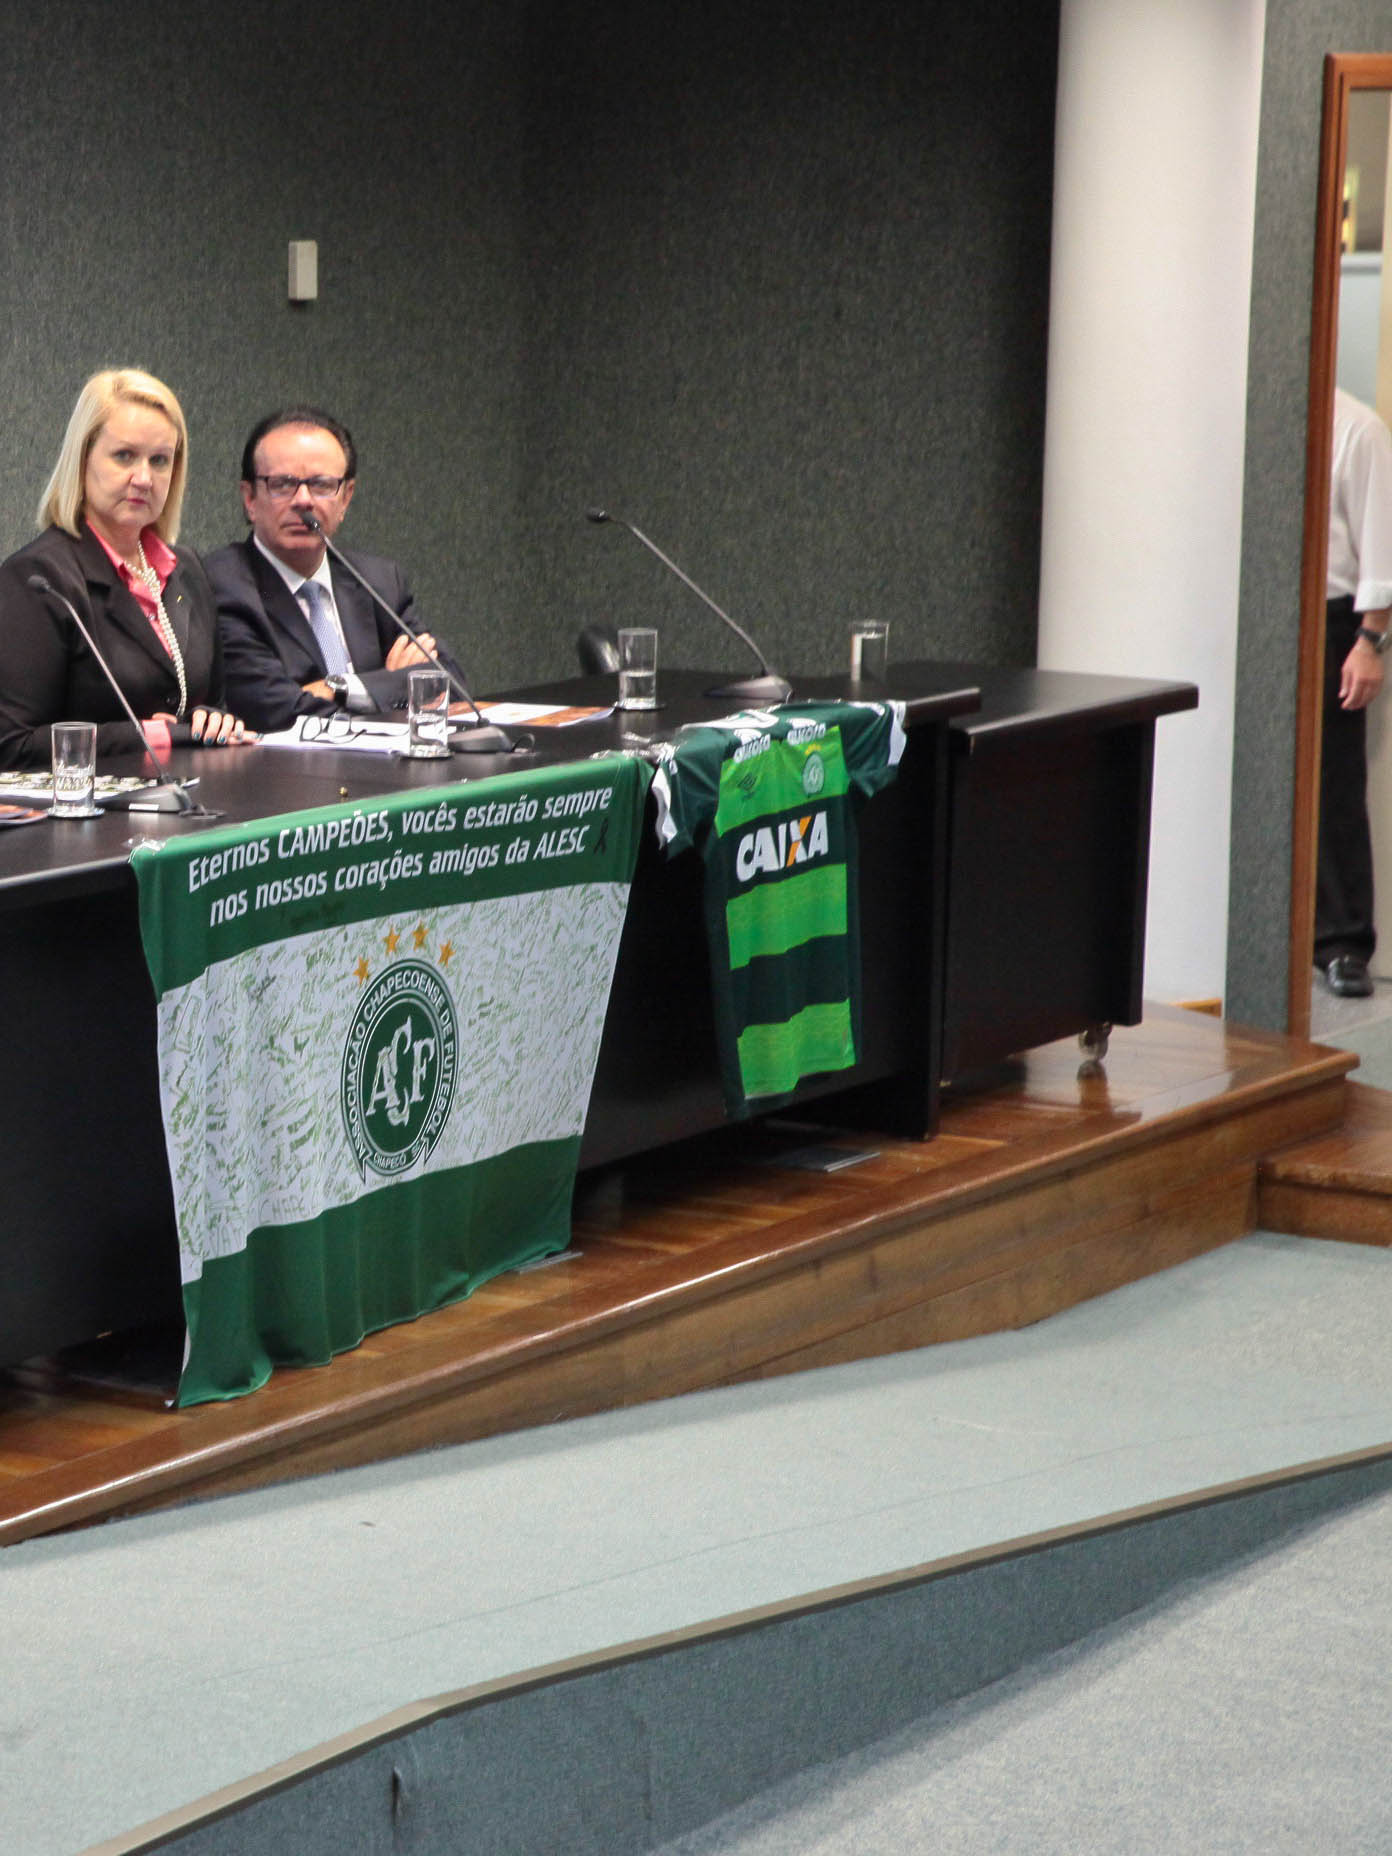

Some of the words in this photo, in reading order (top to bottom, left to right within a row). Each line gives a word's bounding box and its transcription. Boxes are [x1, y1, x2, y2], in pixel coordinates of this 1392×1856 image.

[188, 838, 270, 893] Eternos
[277, 809, 393, 859] CAMPEÕES,
[401, 801, 458, 835] vocês
[463, 794, 539, 829] estarão
[542, 787, 613, 819] sempre
[209, 889, 248, 928] nos
[255, 870, 328, 910] nossos
[334, 849, 423, 891] corações
[428, 842, 500, 875] amigos
[504, 836, 531, 865] da
[533, 824, 590, 860] ALESC
[736, 810, 829, 883] CAIXA
[364, 970, 446, 1021] CHAPECOENSE
[439, 1008, 453, 1040] DE
[346, 1021, 367, 1159] ASSOCIAÇÃO
[427, 1041, 455, 1135] FUTEBOL
